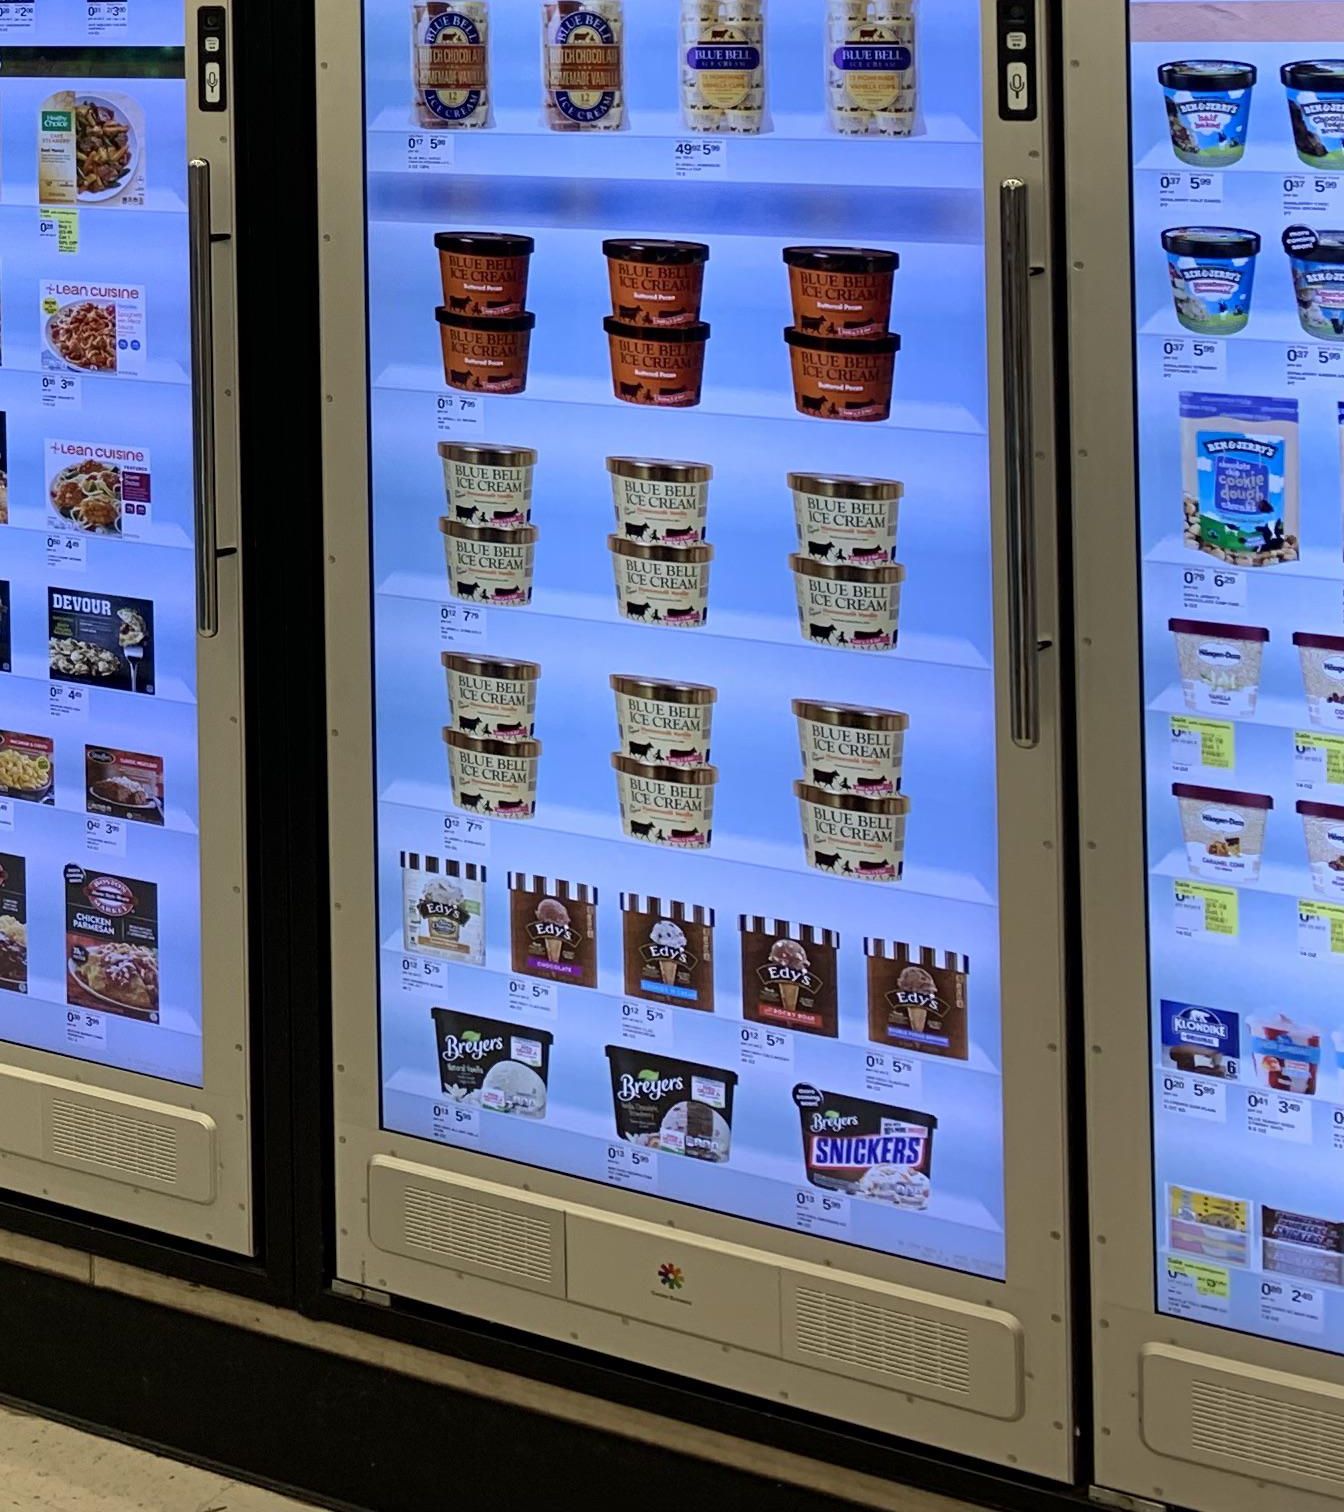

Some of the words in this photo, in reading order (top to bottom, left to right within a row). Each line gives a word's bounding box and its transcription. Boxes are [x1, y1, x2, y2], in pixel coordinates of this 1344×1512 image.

[694, 49, 721, 62] BLUE
[724, 50, 752, 61] BELL
[842, 49, 870, 62] BLUE
[874, 50, 903, 62] BELL
[449, 92, 457, 100] 12
[44, 119, 68, 127] Choice
[618, 262, 652, 278] BLUE
[619, 276, 639, 290] ICE
[641, 278, 693, 292] CREAM
[454, 464, 494, 480] BLUE
[1219, 471, 1264, 487] cookie
[479, 480, 522, 494] CREAM
[624, 480, 663, 496] BLUE
[668, 485, 698, 498] BELL
[1220, 488, 1264, 501] dough
[626, 495, 647, 509] ICE
[650, 497, 697, 511] CREAM
[807, 496, 846, 514] BLUE
[851, 503, 886, 516] BELL
[809, 511, 831, 524] ICE
[834, 515, 885, 528] CREAM
[809, 579, 848, 597] BLUE
[853, 586, 888, 599] BELL
[52, 593, 111, 616] DEVOUR
[811, 592, 832, 606] ICE
[835, 596, 887, 611] CREAM
[812, 806, 853, 824] BLUE
[856, 813, 893, 830] BELL
[814, 822, 837, 837] ICE
[839, 825, 892, 844] CREAM
[94, 876, 127, 890] BOSTON
[94, 901, 128, 915] MARKET
[426, 903, 460, 920] Edy's
[73, 920, 115, 935] PARMESAN
[76, 912, 112, 926] CHICKEN
[536, 921, 572, 940] Edy's
[650, 945, 686, 964] Edy's
[768, 966, 811, 987] Edy's
[897, 991, 938, 1011] Edy's
[1174, 1016, 1226, 1038] KLONDIKE
[442, 1035, 504, 1061] Breyers
[1227, 1060, 1237, 1074] 6
[617, 1075, 684, 1101] Breyers
[810, 1112, 859, 1132] Breyers
[815, 1137, 920, 1165] SNICKERS
